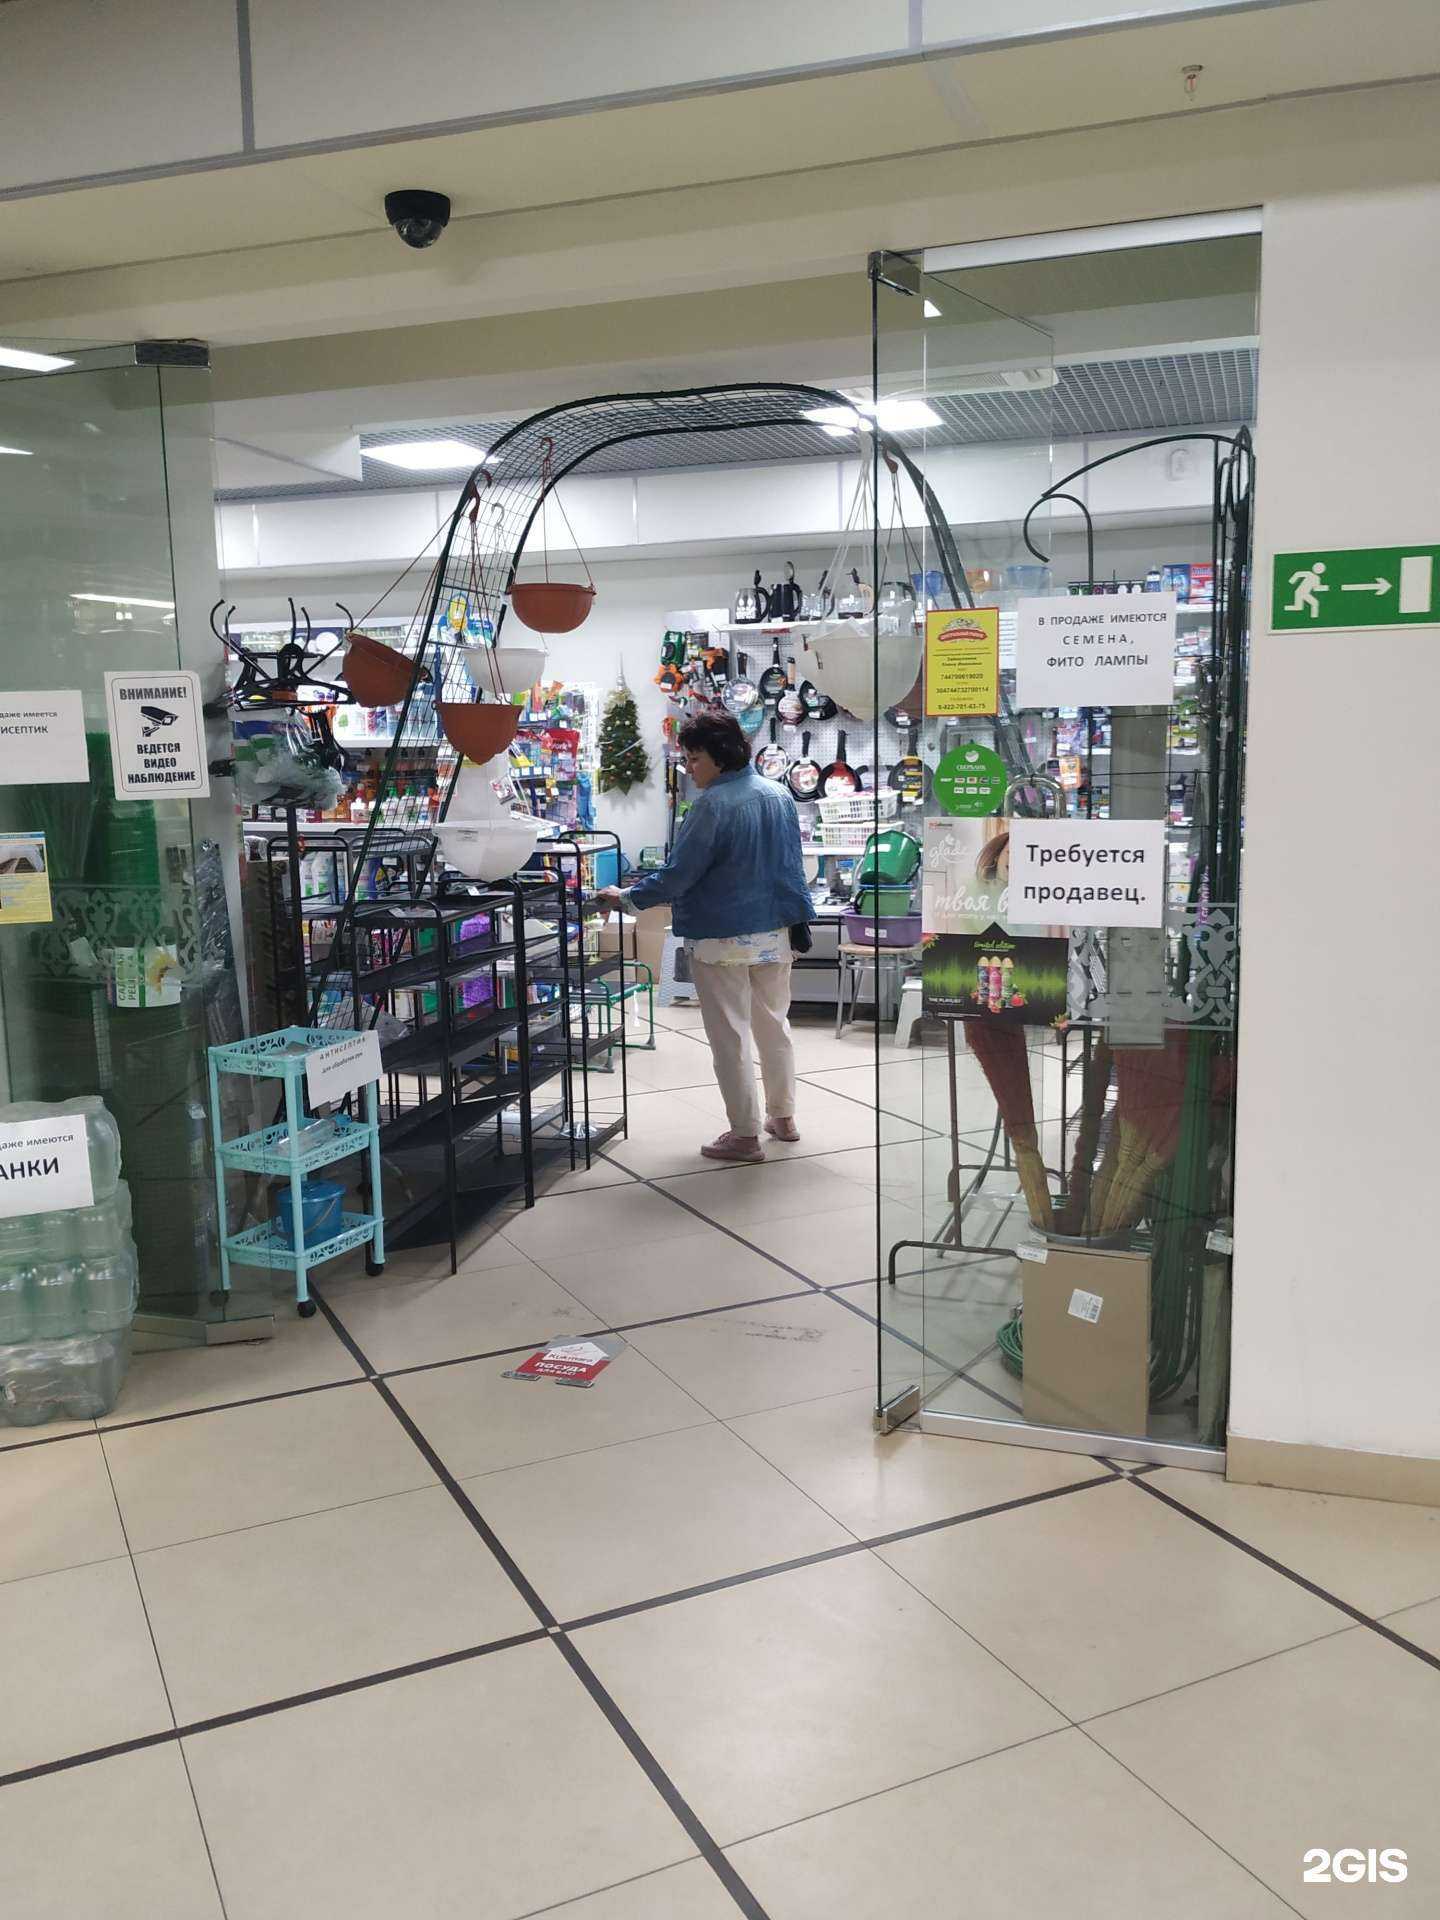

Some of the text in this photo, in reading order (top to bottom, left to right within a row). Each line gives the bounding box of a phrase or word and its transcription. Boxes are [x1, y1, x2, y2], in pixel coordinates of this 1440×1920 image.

[1038, 612, 1167, 626] В ПРОДАЖЕ ИМЕЮТСЯ
[1046, 654, 1149, 667] ФИТО ЛАМПЫ
[119, 686, 187, 701] ВНИМАНИЕ!
[136, 742, 181, 755] ВЕДЕТСЯ
[143, 757, 177, 769] ВИДЕО
[127, 770, 196, 784] НАБЛЮДЕНИЕ
[1026, 844, 1145, 867] Требуется
[1024, 886, 1146, 905] продавец.
[26, 1134, 74, 1147] имеются
